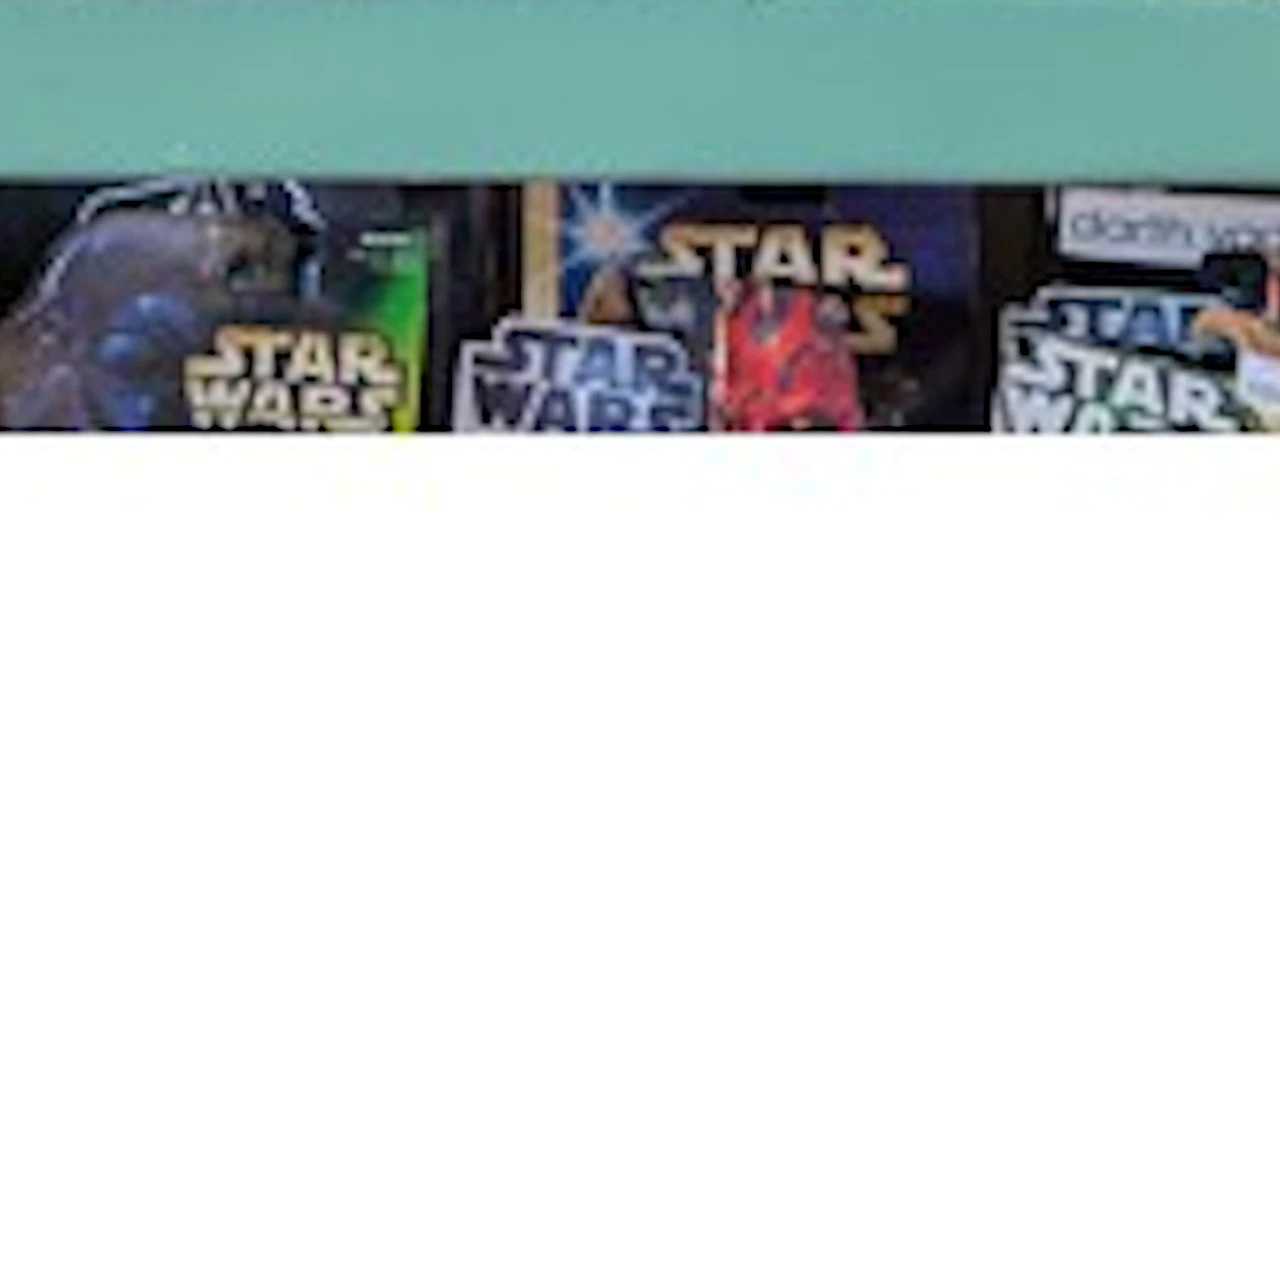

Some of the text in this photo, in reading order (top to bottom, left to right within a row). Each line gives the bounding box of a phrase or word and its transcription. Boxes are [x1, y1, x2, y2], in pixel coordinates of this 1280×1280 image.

[637, 222, 913, 289] STAR
[1071, 207, 1194, 246] darth
[1008, 299, 1202, 348] STA
[185, 325, 400, 385] STAR
[473, 329, 699, 397] STAR
[1003, 339, 1240, 430] STAR
[186, 376, 400, 431] WARS
